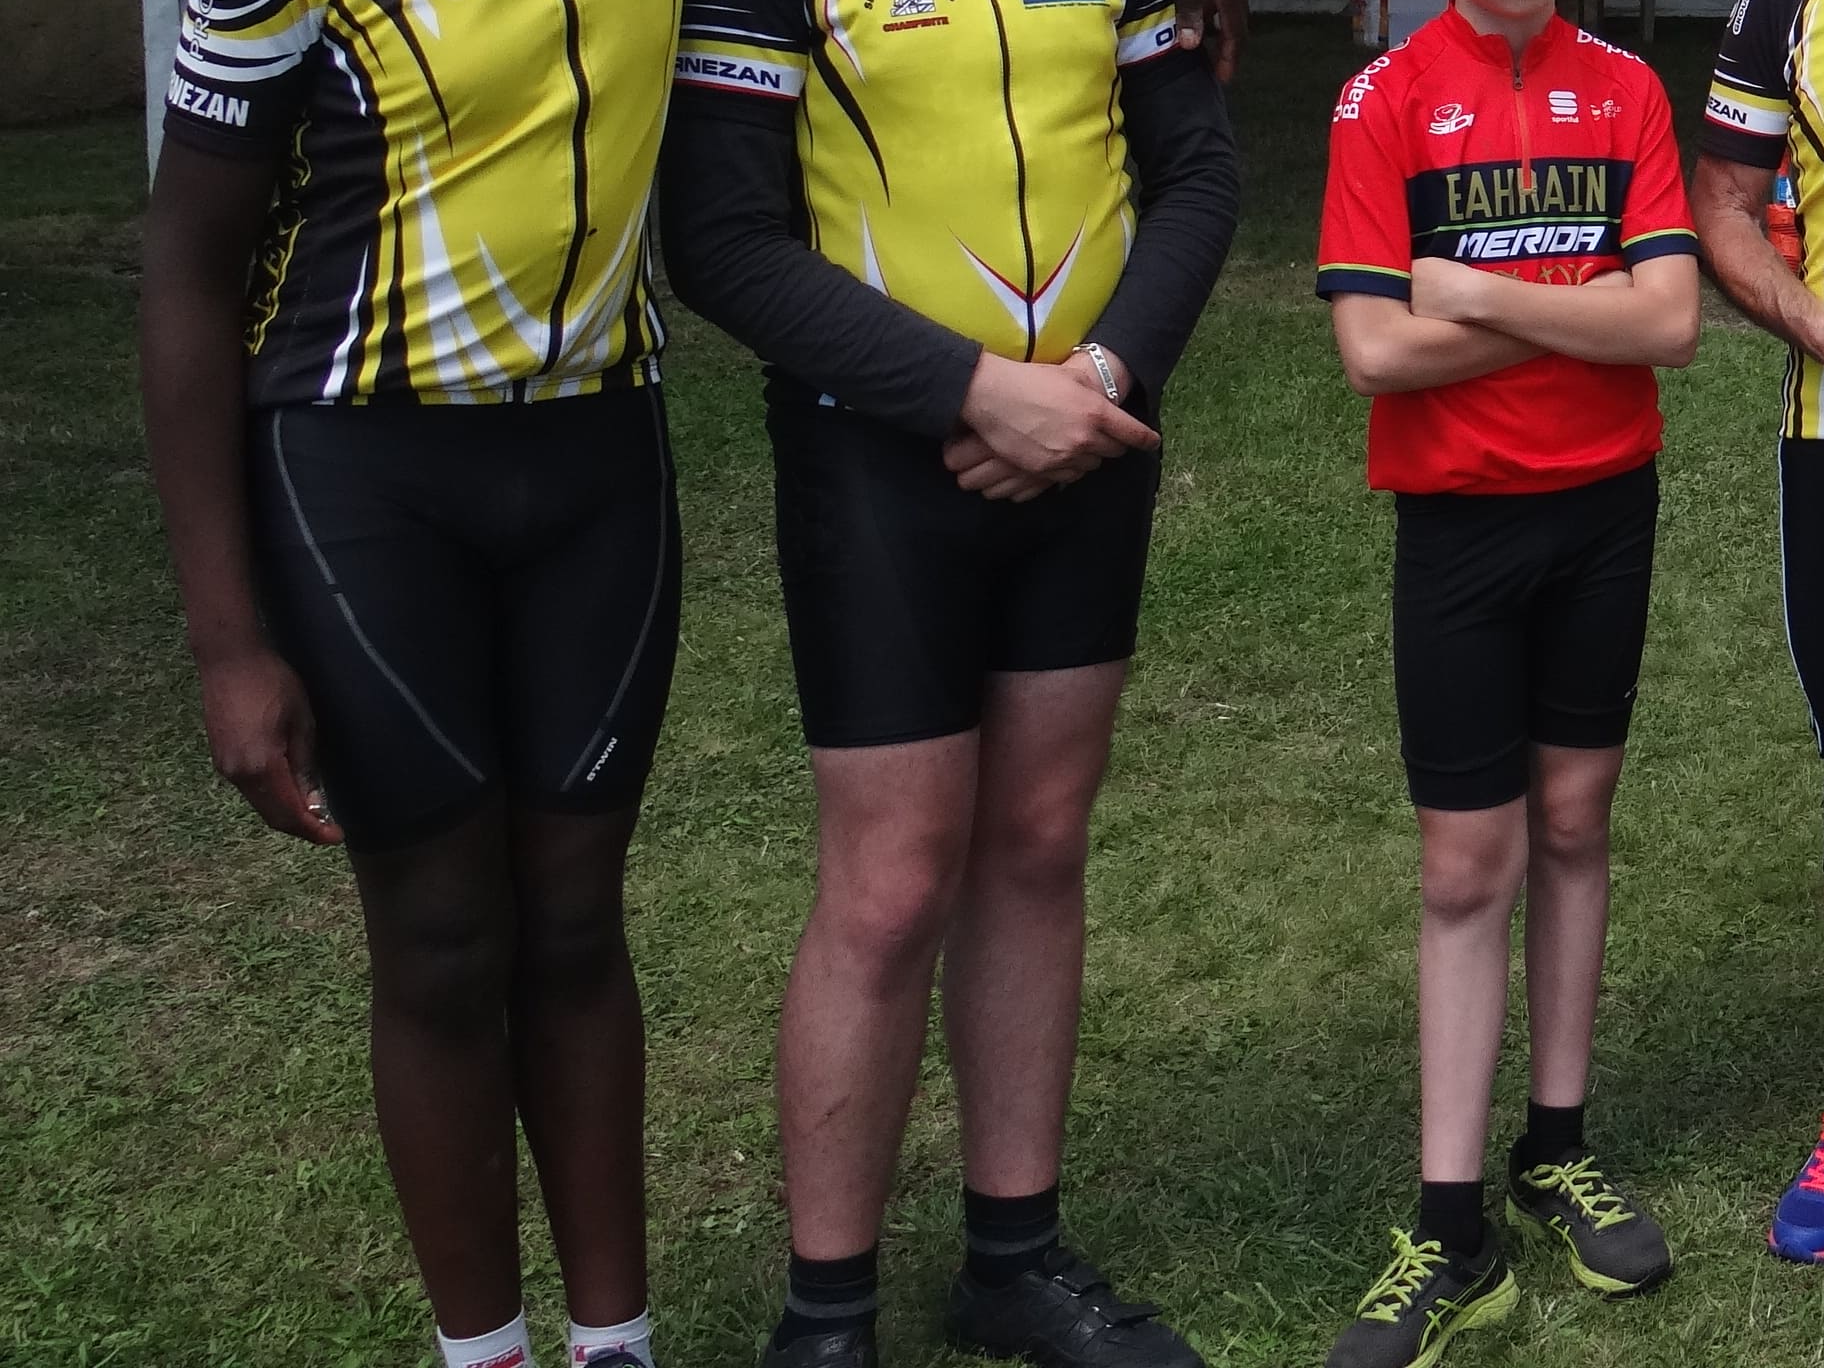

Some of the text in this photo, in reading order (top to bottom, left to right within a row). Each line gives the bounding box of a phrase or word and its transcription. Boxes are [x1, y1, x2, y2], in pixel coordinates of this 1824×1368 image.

[168, 72, 250, 128] NEZAN
[1341, 55, 1391, 120] Bapco
[1454, 226, 1606, 259] MERIDA
